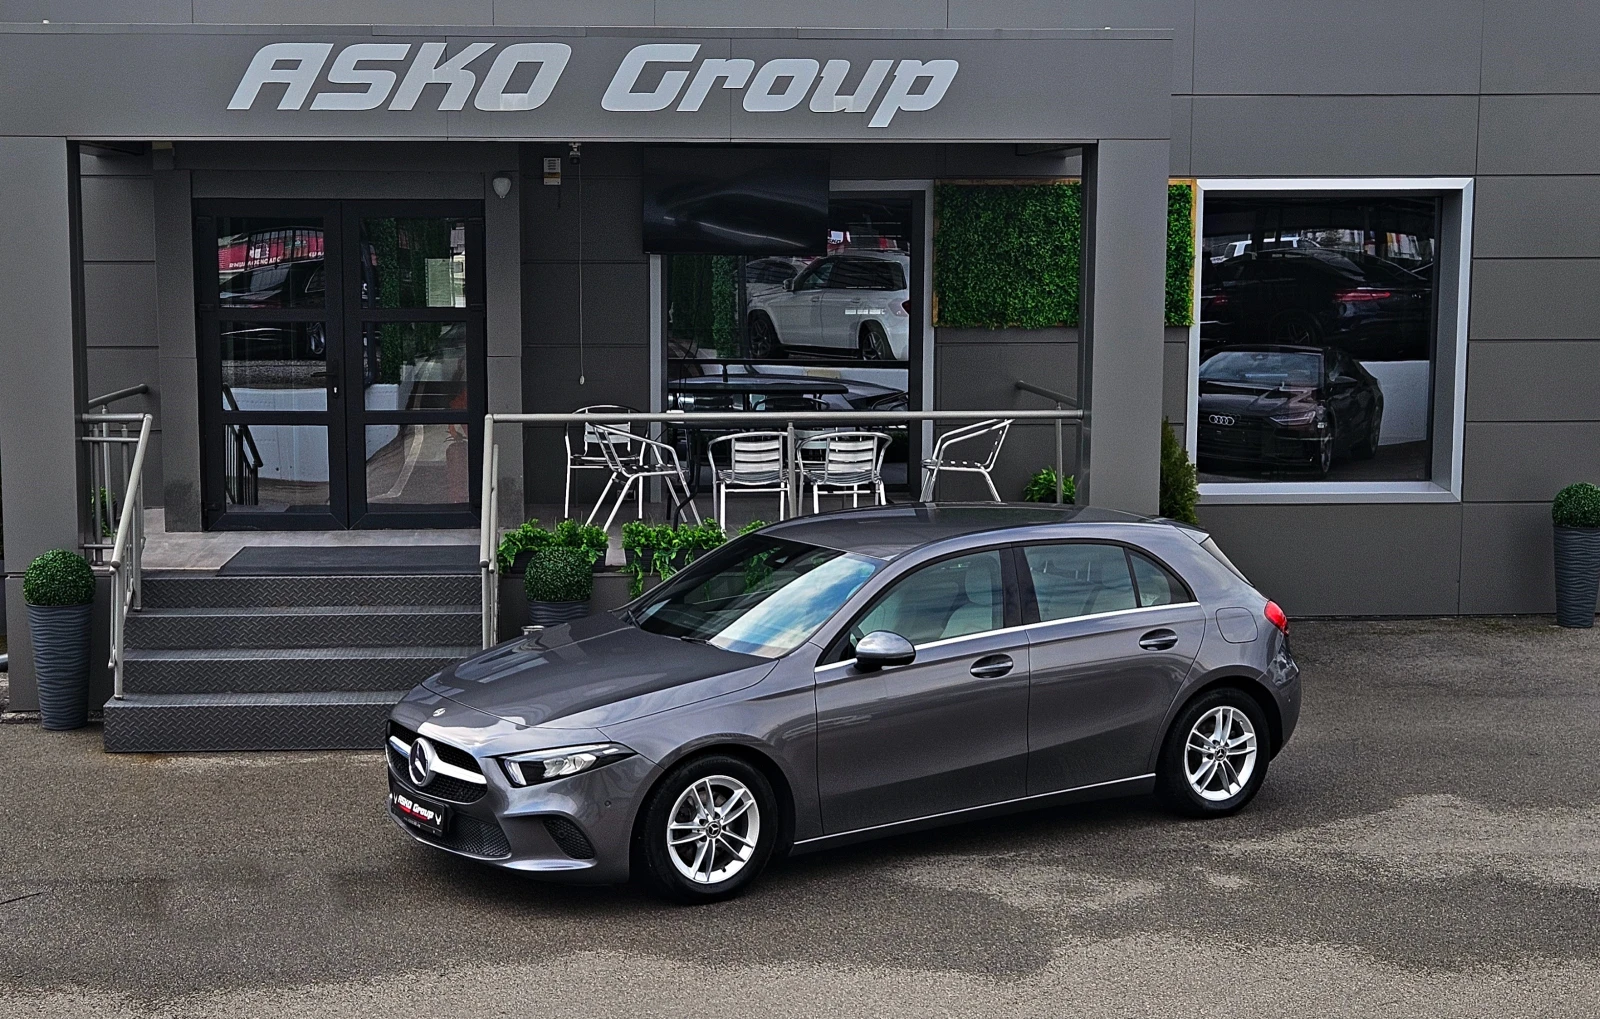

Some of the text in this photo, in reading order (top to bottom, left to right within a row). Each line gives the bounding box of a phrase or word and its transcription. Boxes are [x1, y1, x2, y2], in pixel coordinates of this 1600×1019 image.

[226, 42, 960, 128] ASKO Group
[398, 795, 434, 820] ASKO Group
